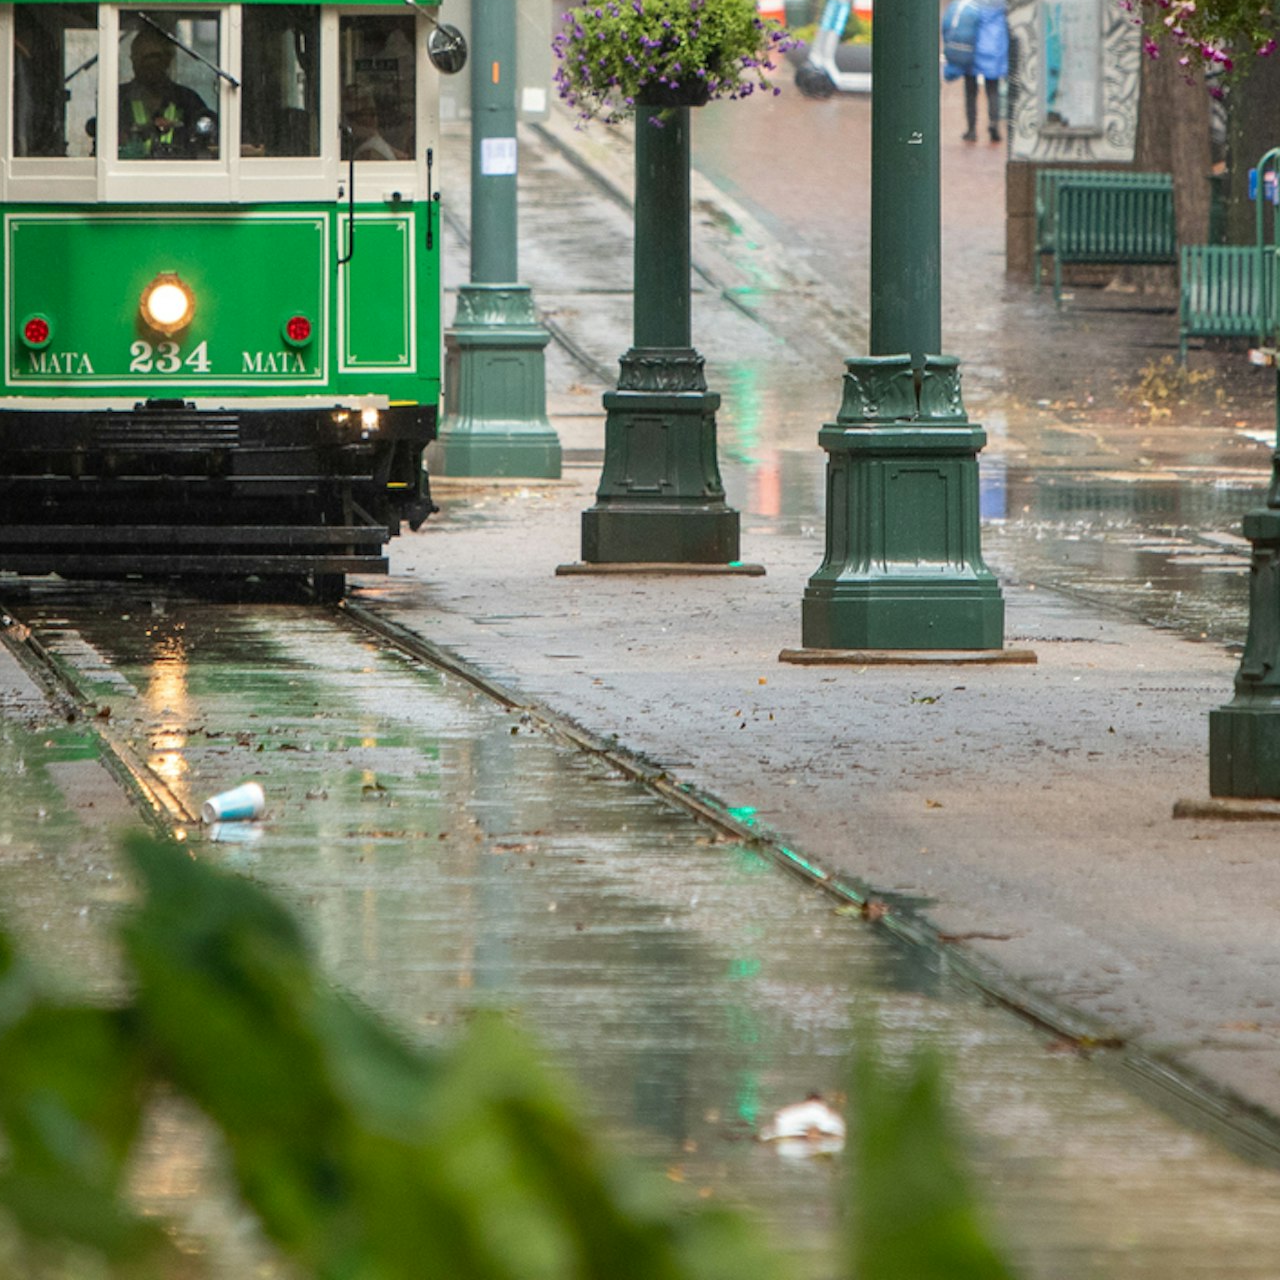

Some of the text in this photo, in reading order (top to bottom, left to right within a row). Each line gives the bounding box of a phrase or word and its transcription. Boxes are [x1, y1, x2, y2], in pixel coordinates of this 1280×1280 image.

[29, 340, 306, 374] MATA 234 MATA
